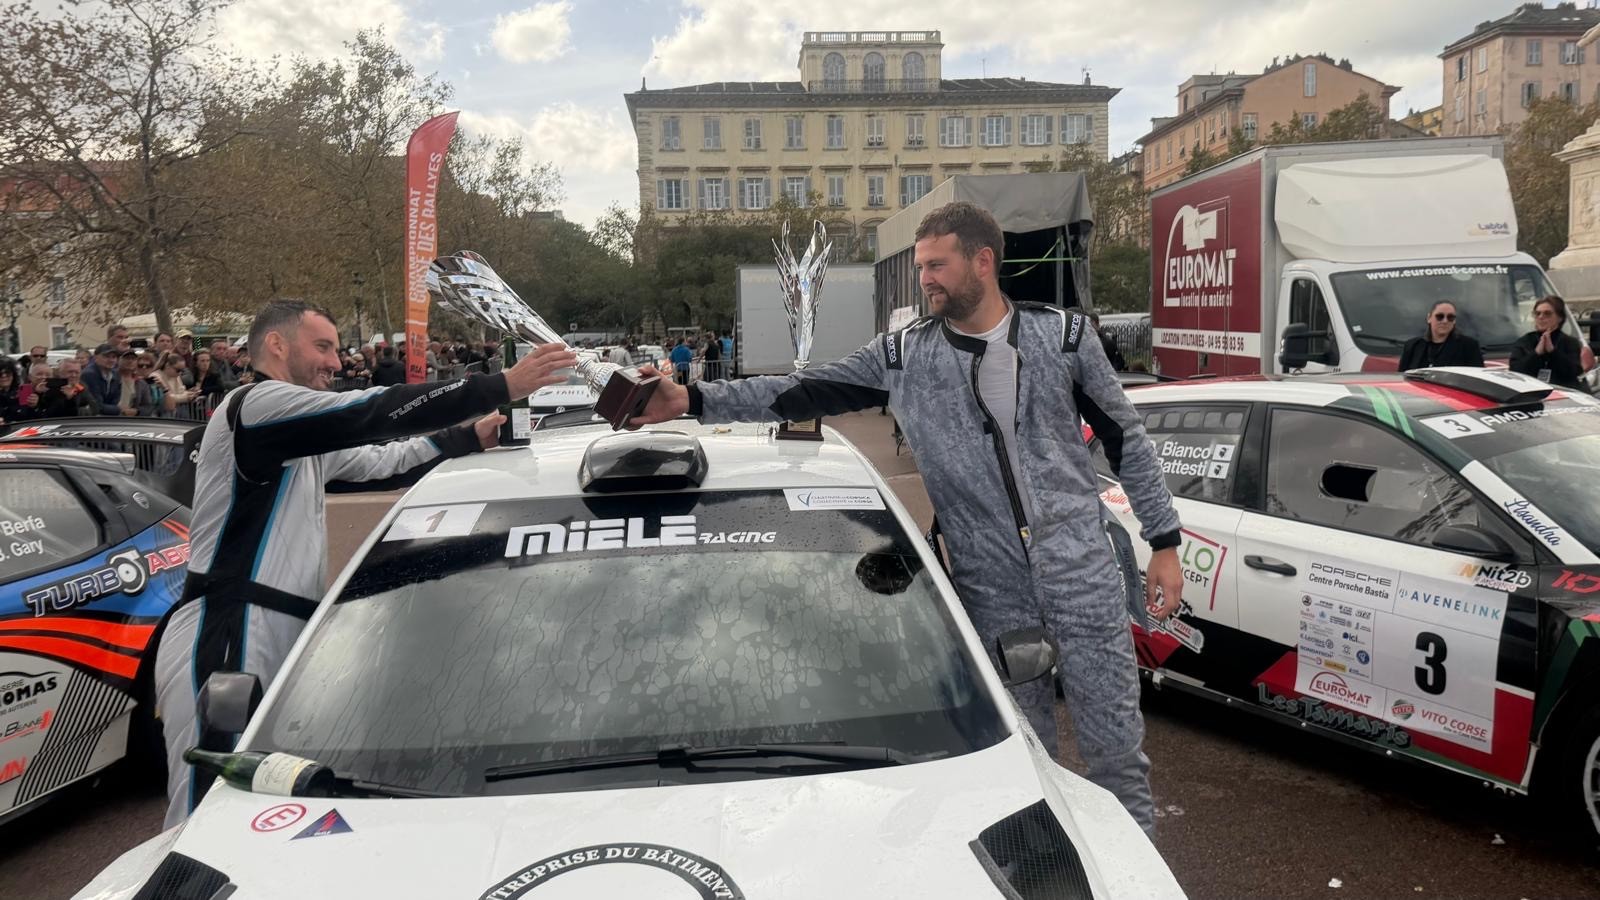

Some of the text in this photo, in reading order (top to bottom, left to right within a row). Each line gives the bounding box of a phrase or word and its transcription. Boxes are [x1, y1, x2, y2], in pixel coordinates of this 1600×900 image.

[422, 152, 442, 219] RALLYES
[409, 188, 421, 302] CHAMPIONNAT
[417, 221, 435, 253] DES
[1169, 248, 1237, 290] EUROMAT
[1366, 264, 1509, 281] www.euromat-corse.fr
[1068, 313, 1083, 344] sparco
[1161, 331, 1180, 345] LOCATION
[886, 334, 898, 364] sparco
[1443, 418, 1472, 433] 3
[1480, 408, 1530, 427] AMD
[1161, 440, 1211, 460] Bianco
[423, 508, 447, 533] 1
[10, 540, 44, 557] Gary
[1182, 568, 1210, 588] CEPT
[1308, 573, 1390, 600] Centre Porsche Bastia
[1311, 562, 1393, 587] PORSCHE
[1478, 564, 1531, 588] Nit2b
[1411, 590, 1501, 619] AVENELINK
[1172, 619, 1193, 635] STIHL
[1414, 631, 1448, 696] 3
[0, 676, 57, 707] OMAS
[1315, 680, 1372, 705] EUROMAT
[1257, 683, 1299, 714] Les
[1298, 697, 1413, 749] Tamaris
[1421, 708, 1448, 726] VITO
[1449, 718, 1488, 738] CORSE
[604, 846, 640, 860] DU
[641, 847, 734, 900] BÂTIMENT
